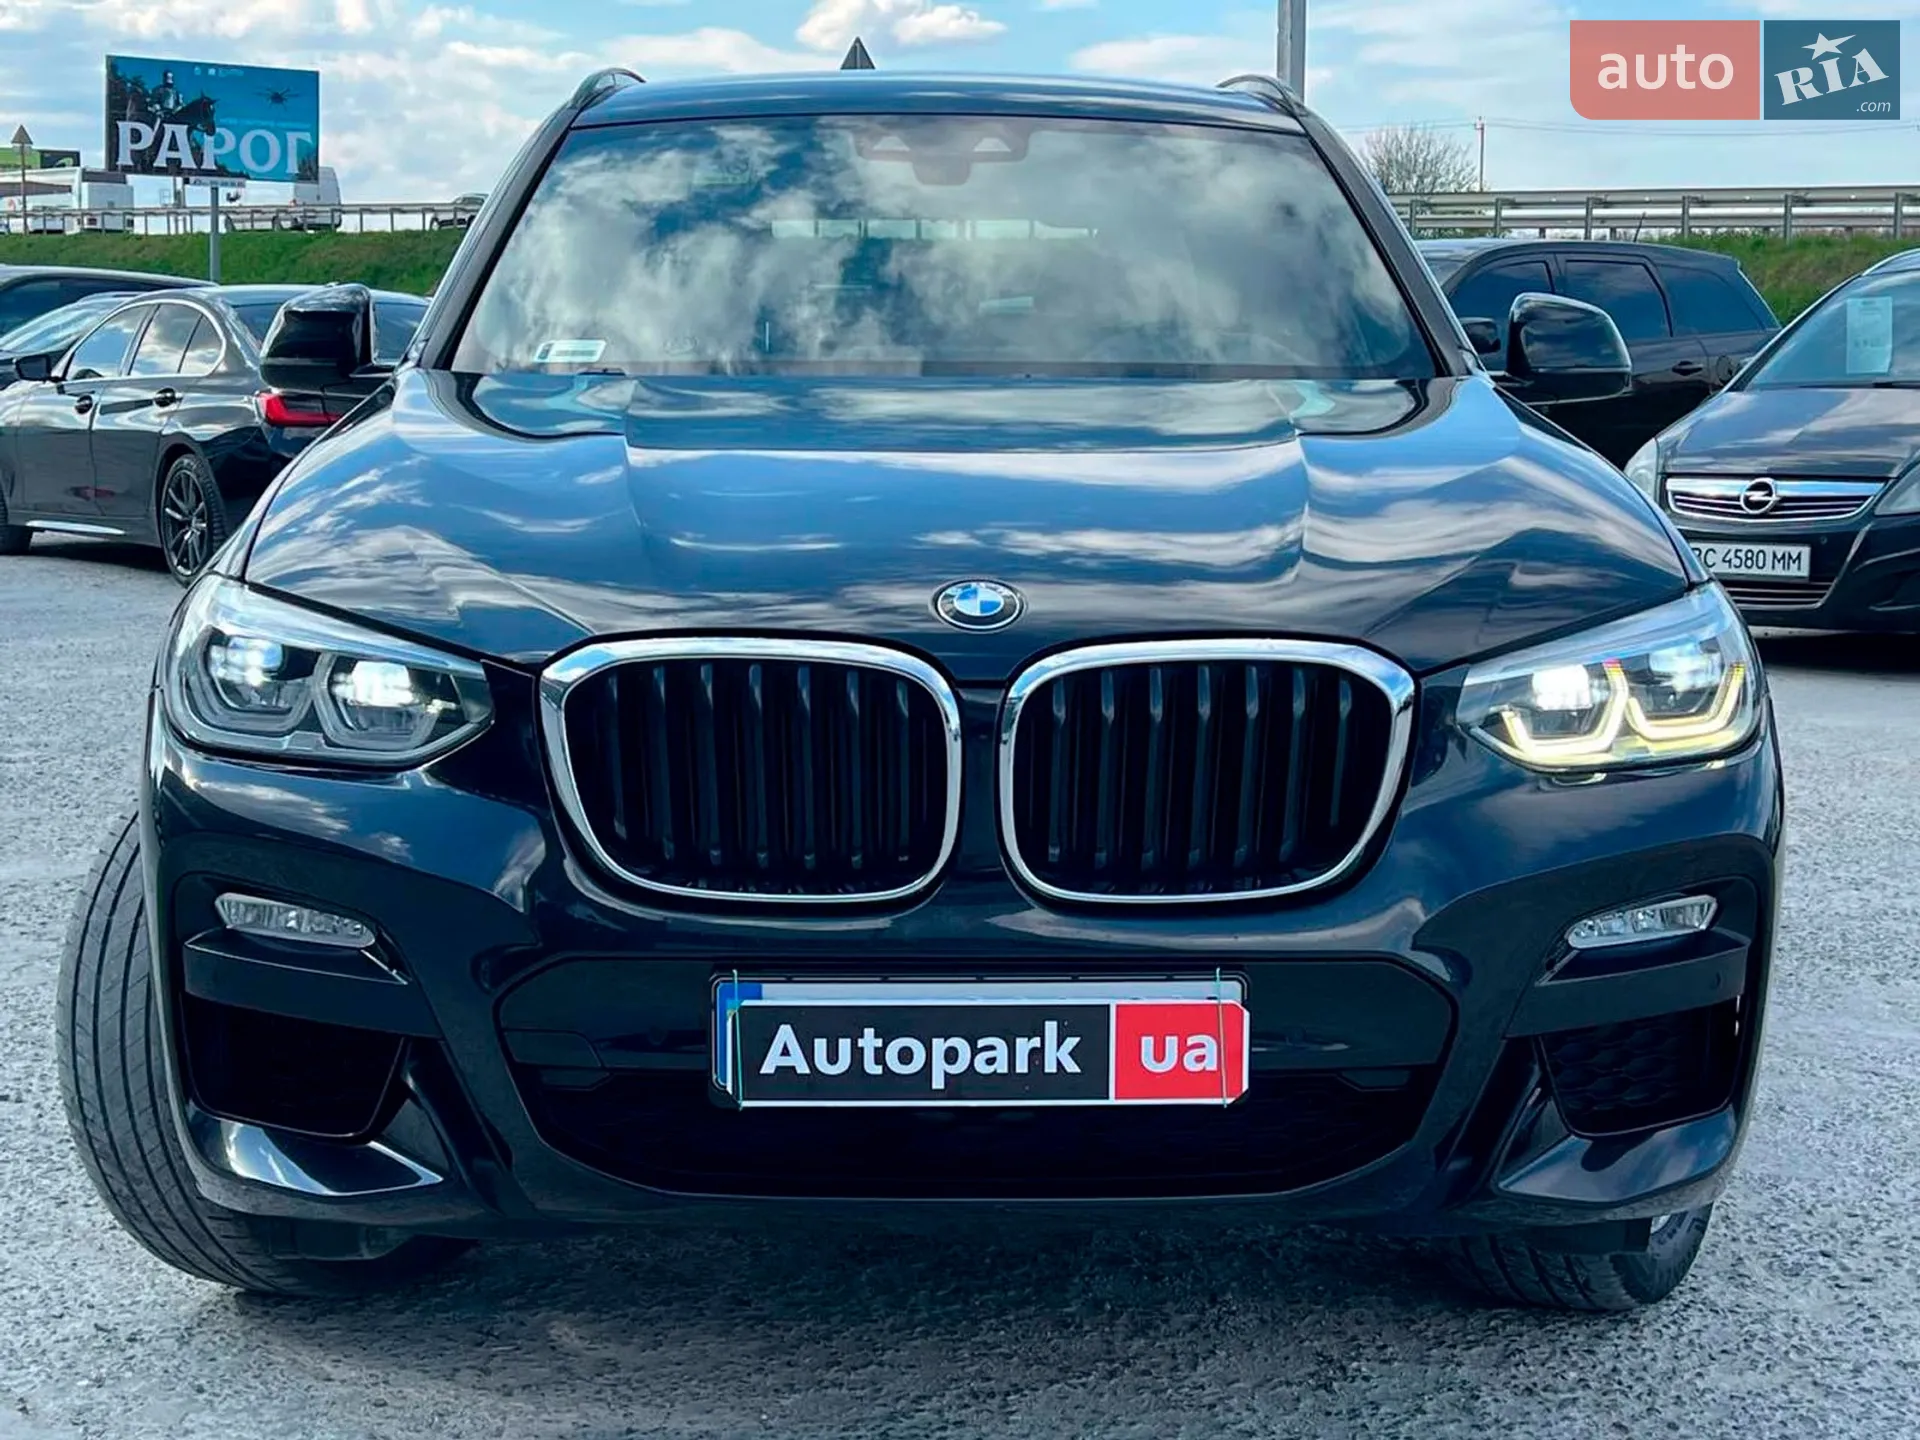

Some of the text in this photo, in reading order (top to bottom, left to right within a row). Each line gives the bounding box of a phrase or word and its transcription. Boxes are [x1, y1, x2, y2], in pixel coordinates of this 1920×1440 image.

[115, 120, 313, 174] РАРОГ
[1722, 548, 1766, 570] 4580
[1771, 550, 1802, 571] MM
[759, 1021, 1219, 1090] Autopark ua
